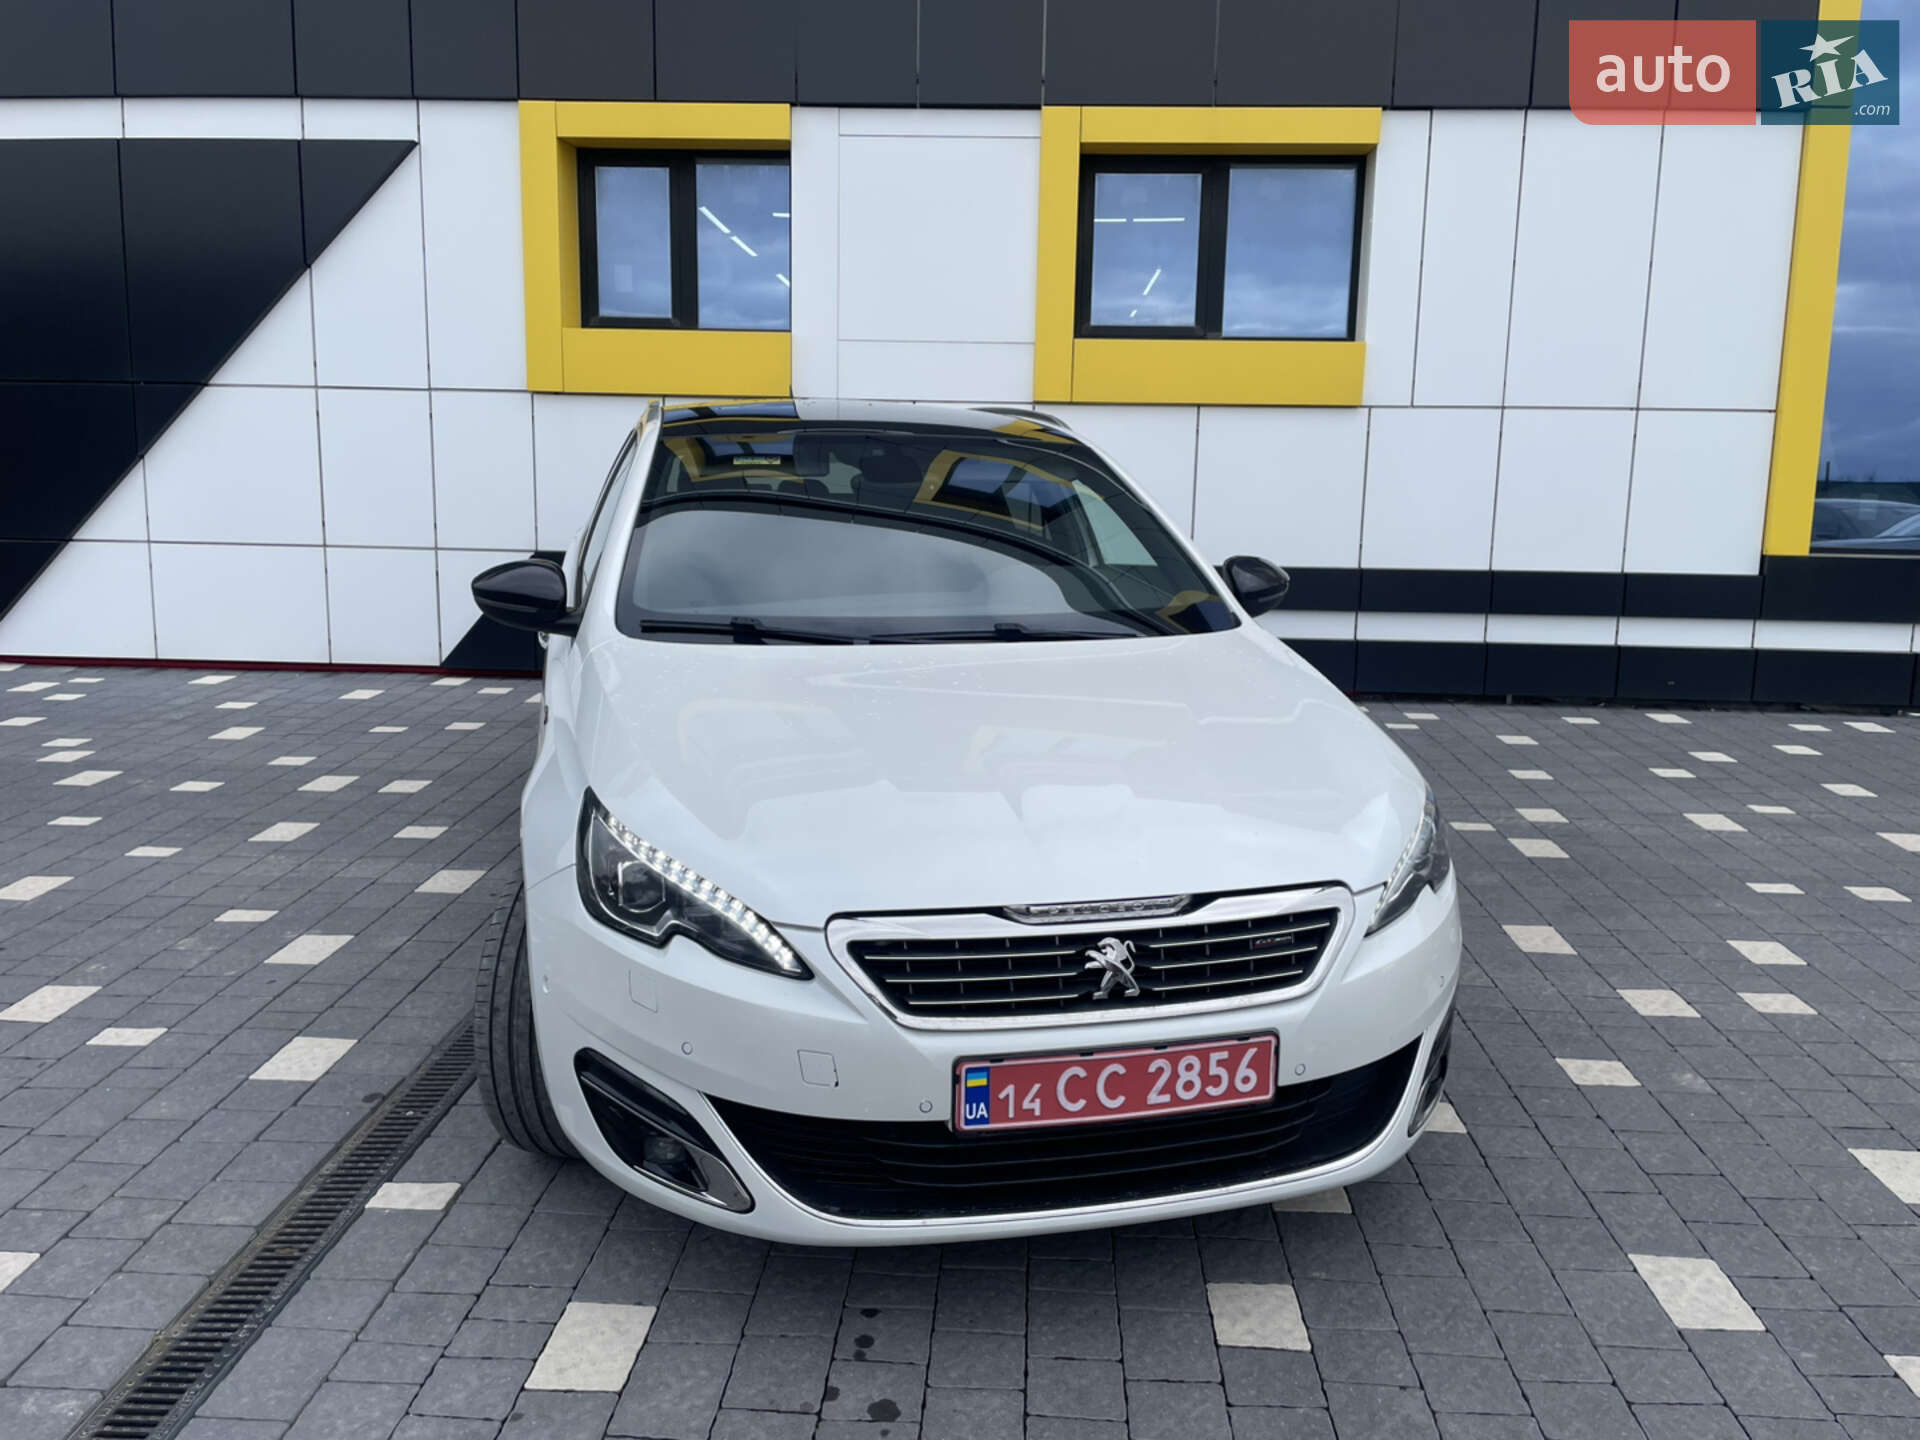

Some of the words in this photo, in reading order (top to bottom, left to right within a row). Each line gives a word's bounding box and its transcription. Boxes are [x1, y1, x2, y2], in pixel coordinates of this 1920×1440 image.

[998, 1083, 1042, 1119] 14
[1056, 1063, 1127, 1112] CC
[1146, 1047, 1259, 1105] 2856
[965, 1102, 989, 1120] UA
